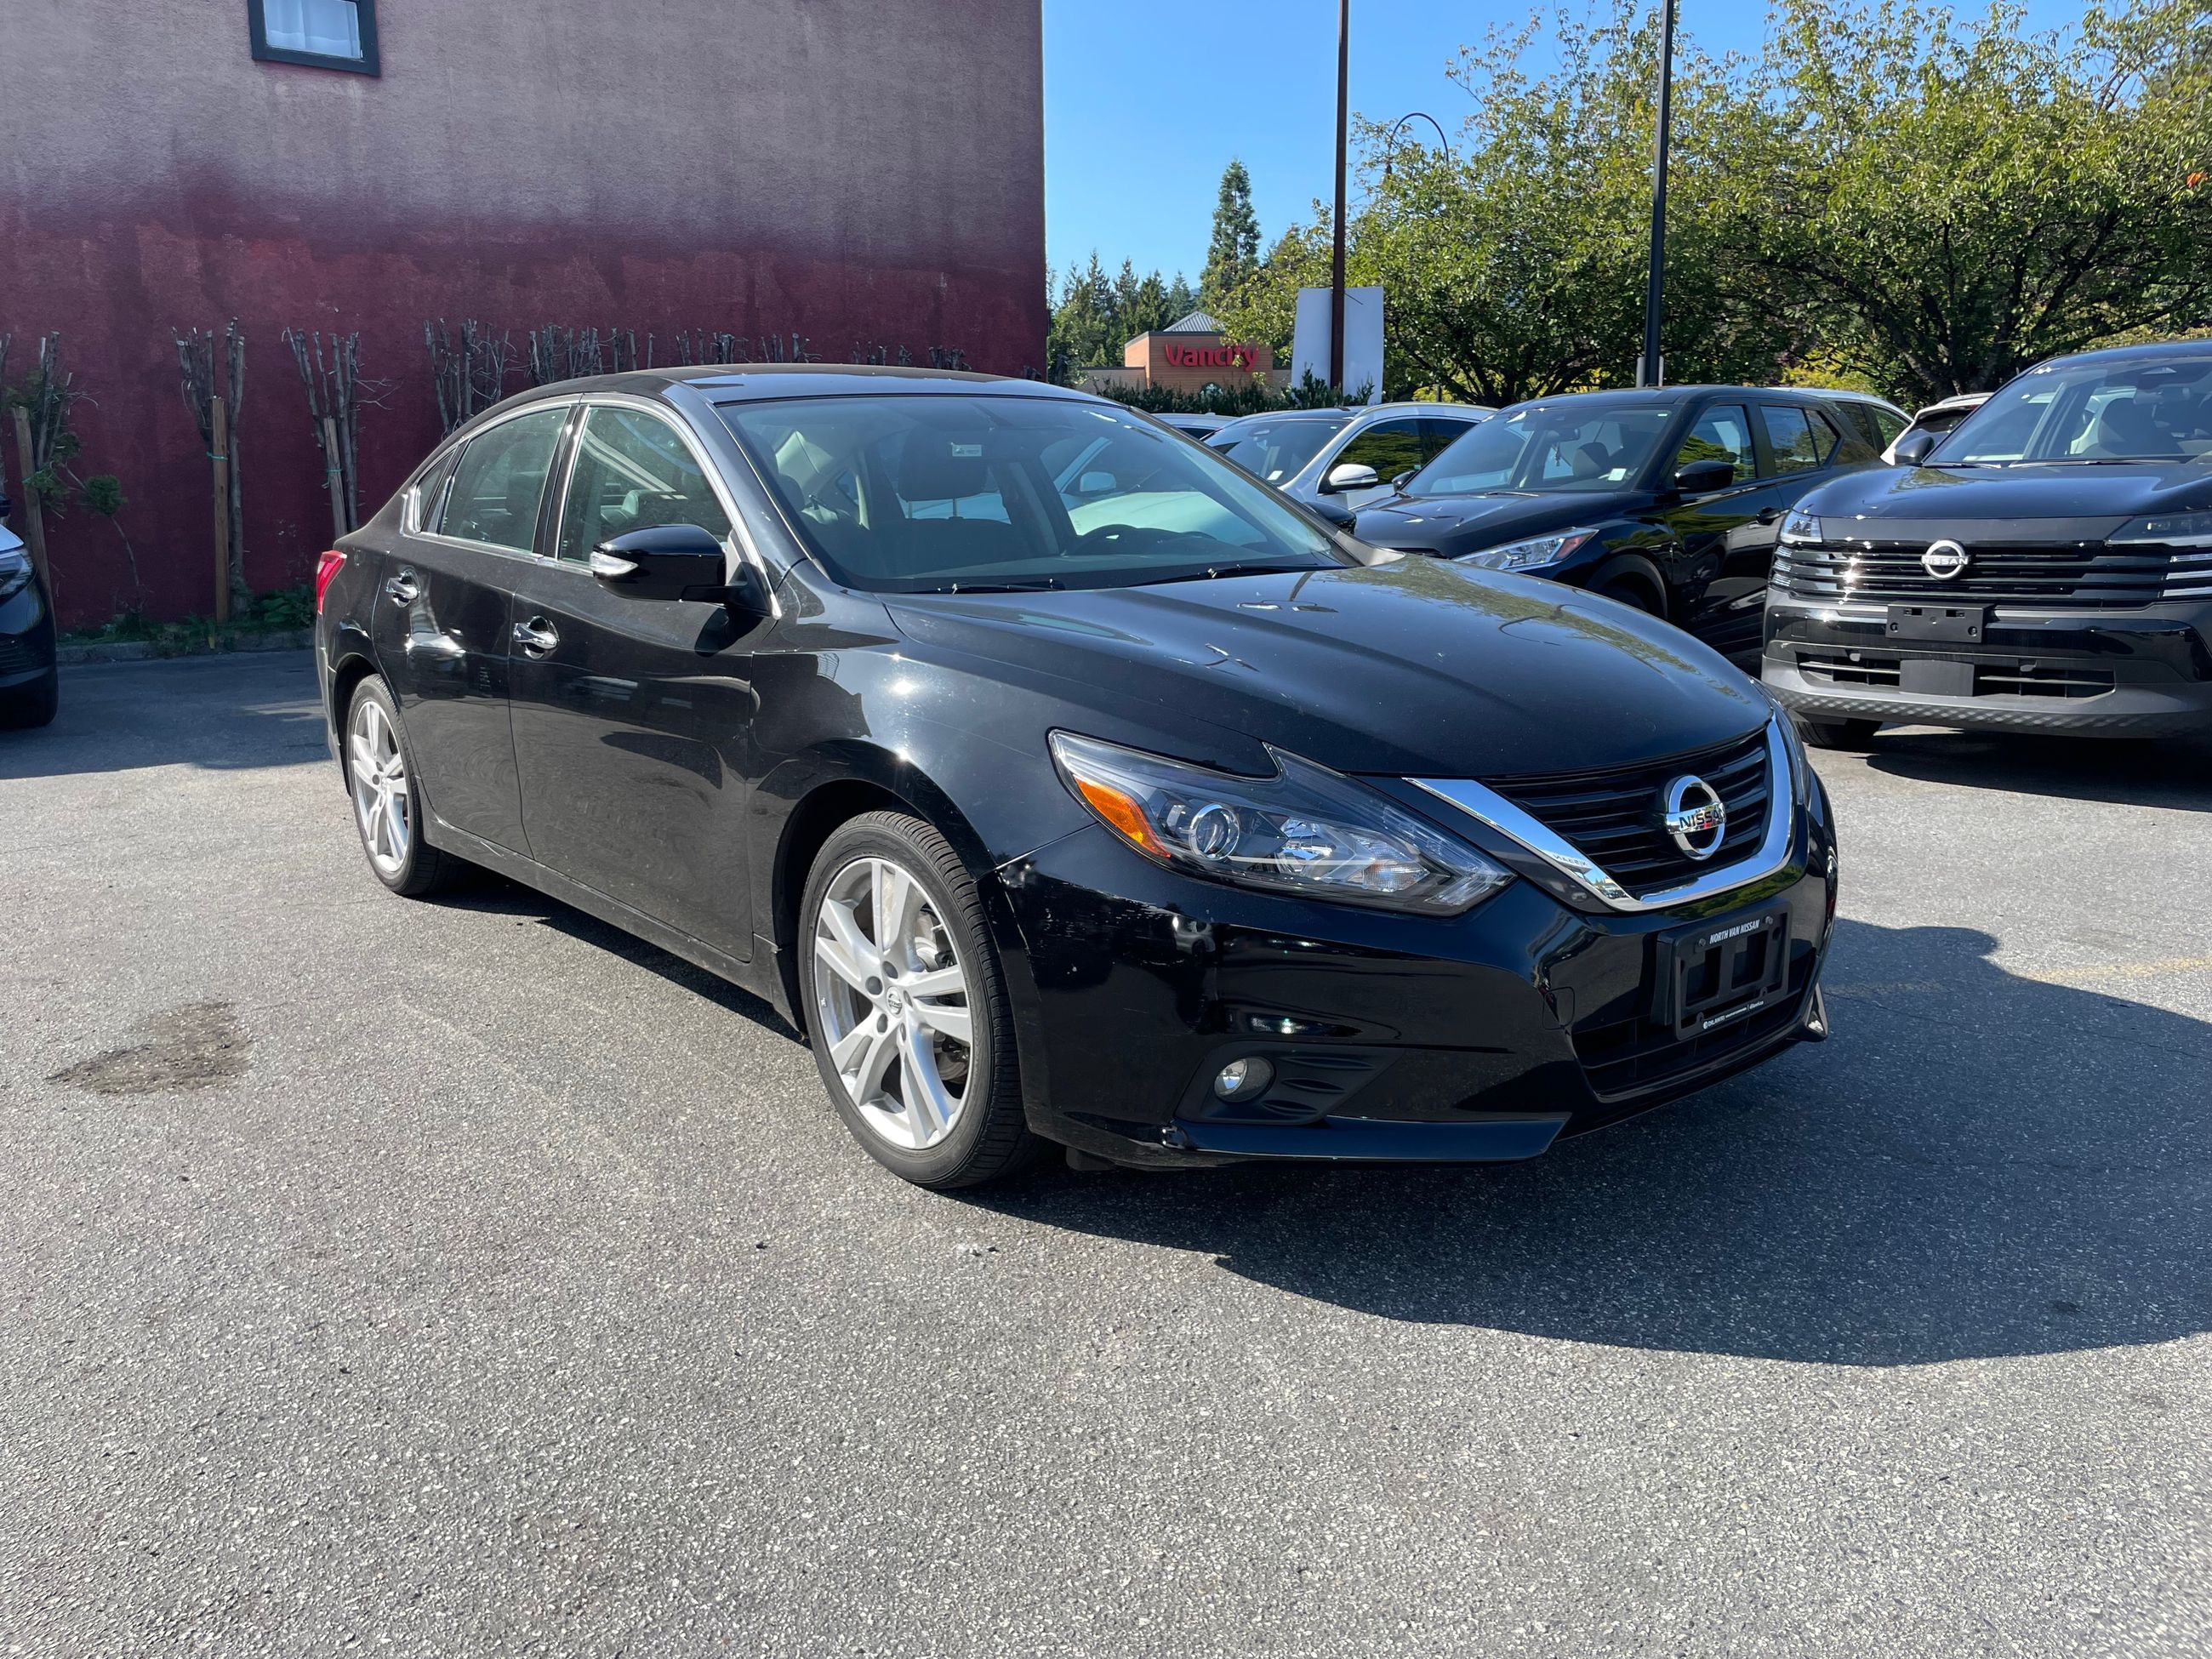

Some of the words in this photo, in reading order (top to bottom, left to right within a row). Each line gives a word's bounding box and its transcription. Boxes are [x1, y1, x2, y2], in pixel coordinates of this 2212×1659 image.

[1922, 556, 1969, 565] NISSAN
[1679, 805, 1725, 829] NISSAN
[1709, 929, 1729, 944] NORTH
[1729, 925, 1741, 938] VAN
[1740, 919, 1760, 934] NISSAN
